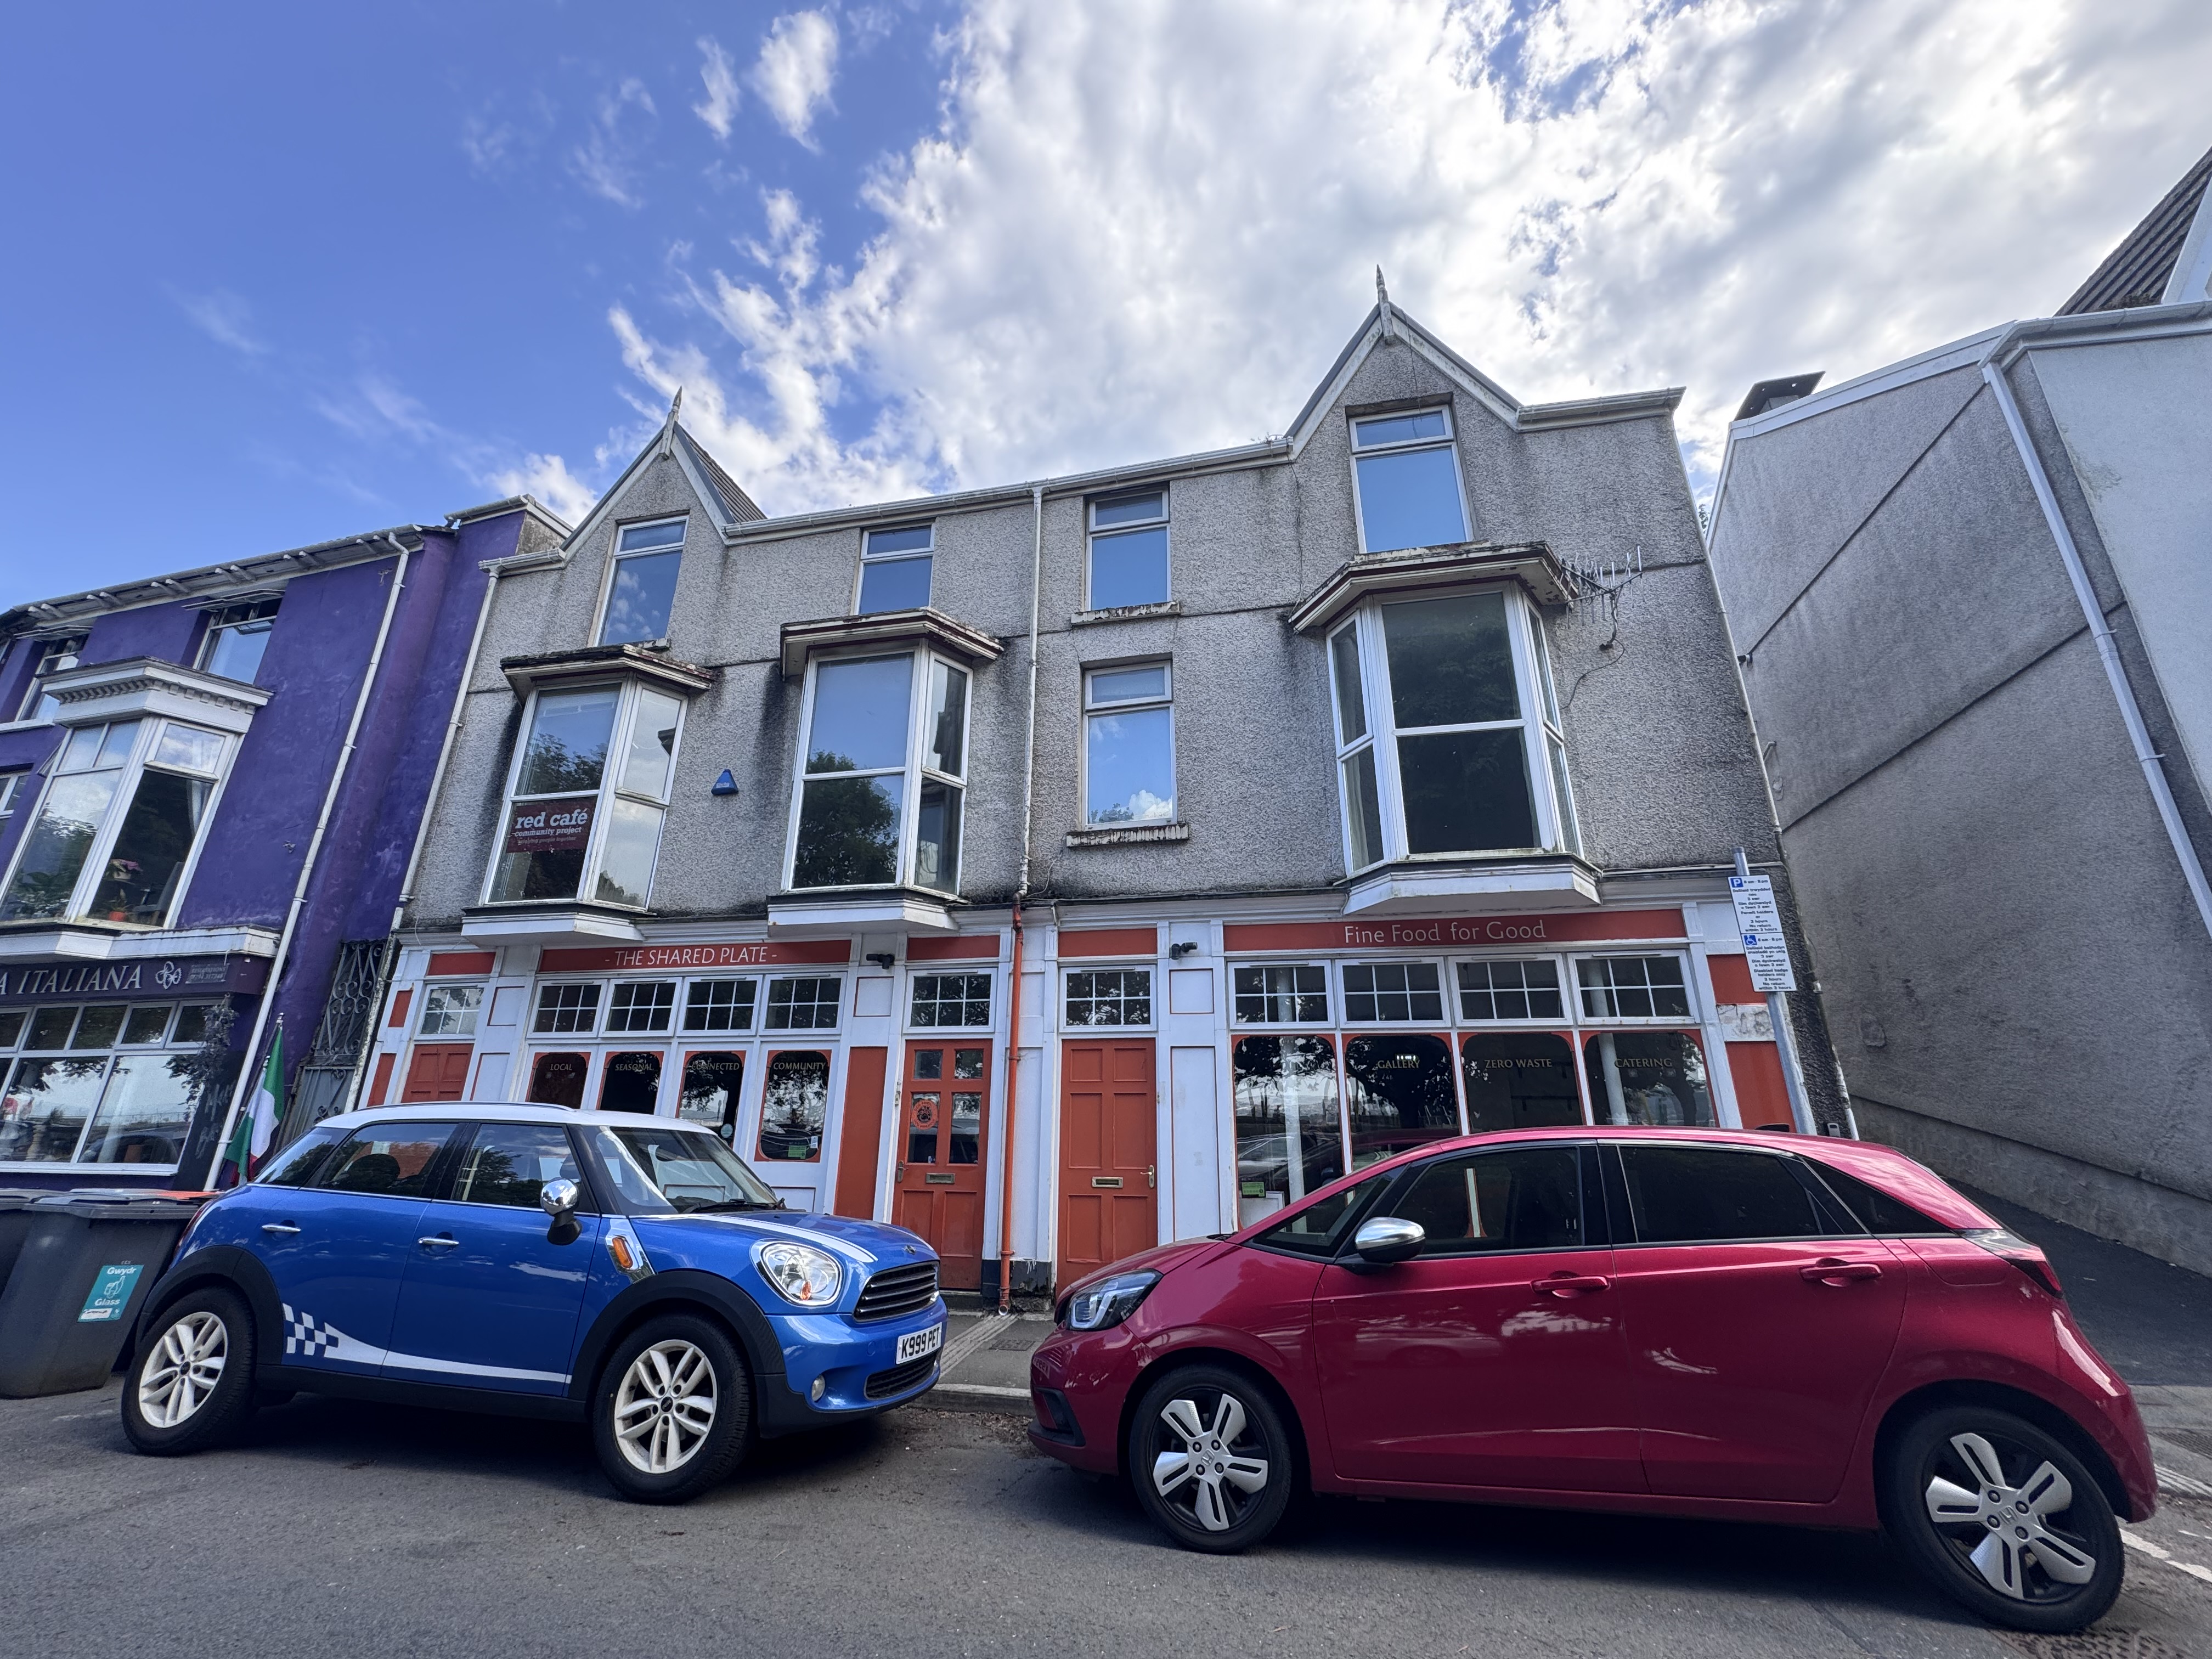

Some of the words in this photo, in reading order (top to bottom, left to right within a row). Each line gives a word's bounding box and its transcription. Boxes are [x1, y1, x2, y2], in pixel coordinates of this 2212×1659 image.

[515, 811, 546, 830] red
[550, 808, 588, 827] café
[515, 827, 555, 837] community
[556, 826, 582, 835] project
[1344, 926, 1385, 944] Fine
[1391, 923, 1441, 943] Food
[1450, 922, 1480, 940] for
[1486, 919, 1547, 939] Good
[614, 950, 645, 966] THE
[647, 947, 715, 965] SHARED
[719, 946, 769, 963] PLATE
[16, 964, 142, 995] ITALIANA
[691, 1062, 740, 1070] CONNECTED
[773, 1062, 826, 1070] COMMUNITY
[1378, 1059, 1420, 1069] GALLERY
[1484, 1059, 1513, 1069] ZERO
[1515, 1058, 1553, 1068] WASTE
[1615, 1058, 1673, 1068] CATERING
[107, 1266, 137, 1276] Gwydr
[94, 1298, 121, 1306] Glass
[901, 1333, 927, 1359] K999
[927, 1327, 940, 1351] PET
